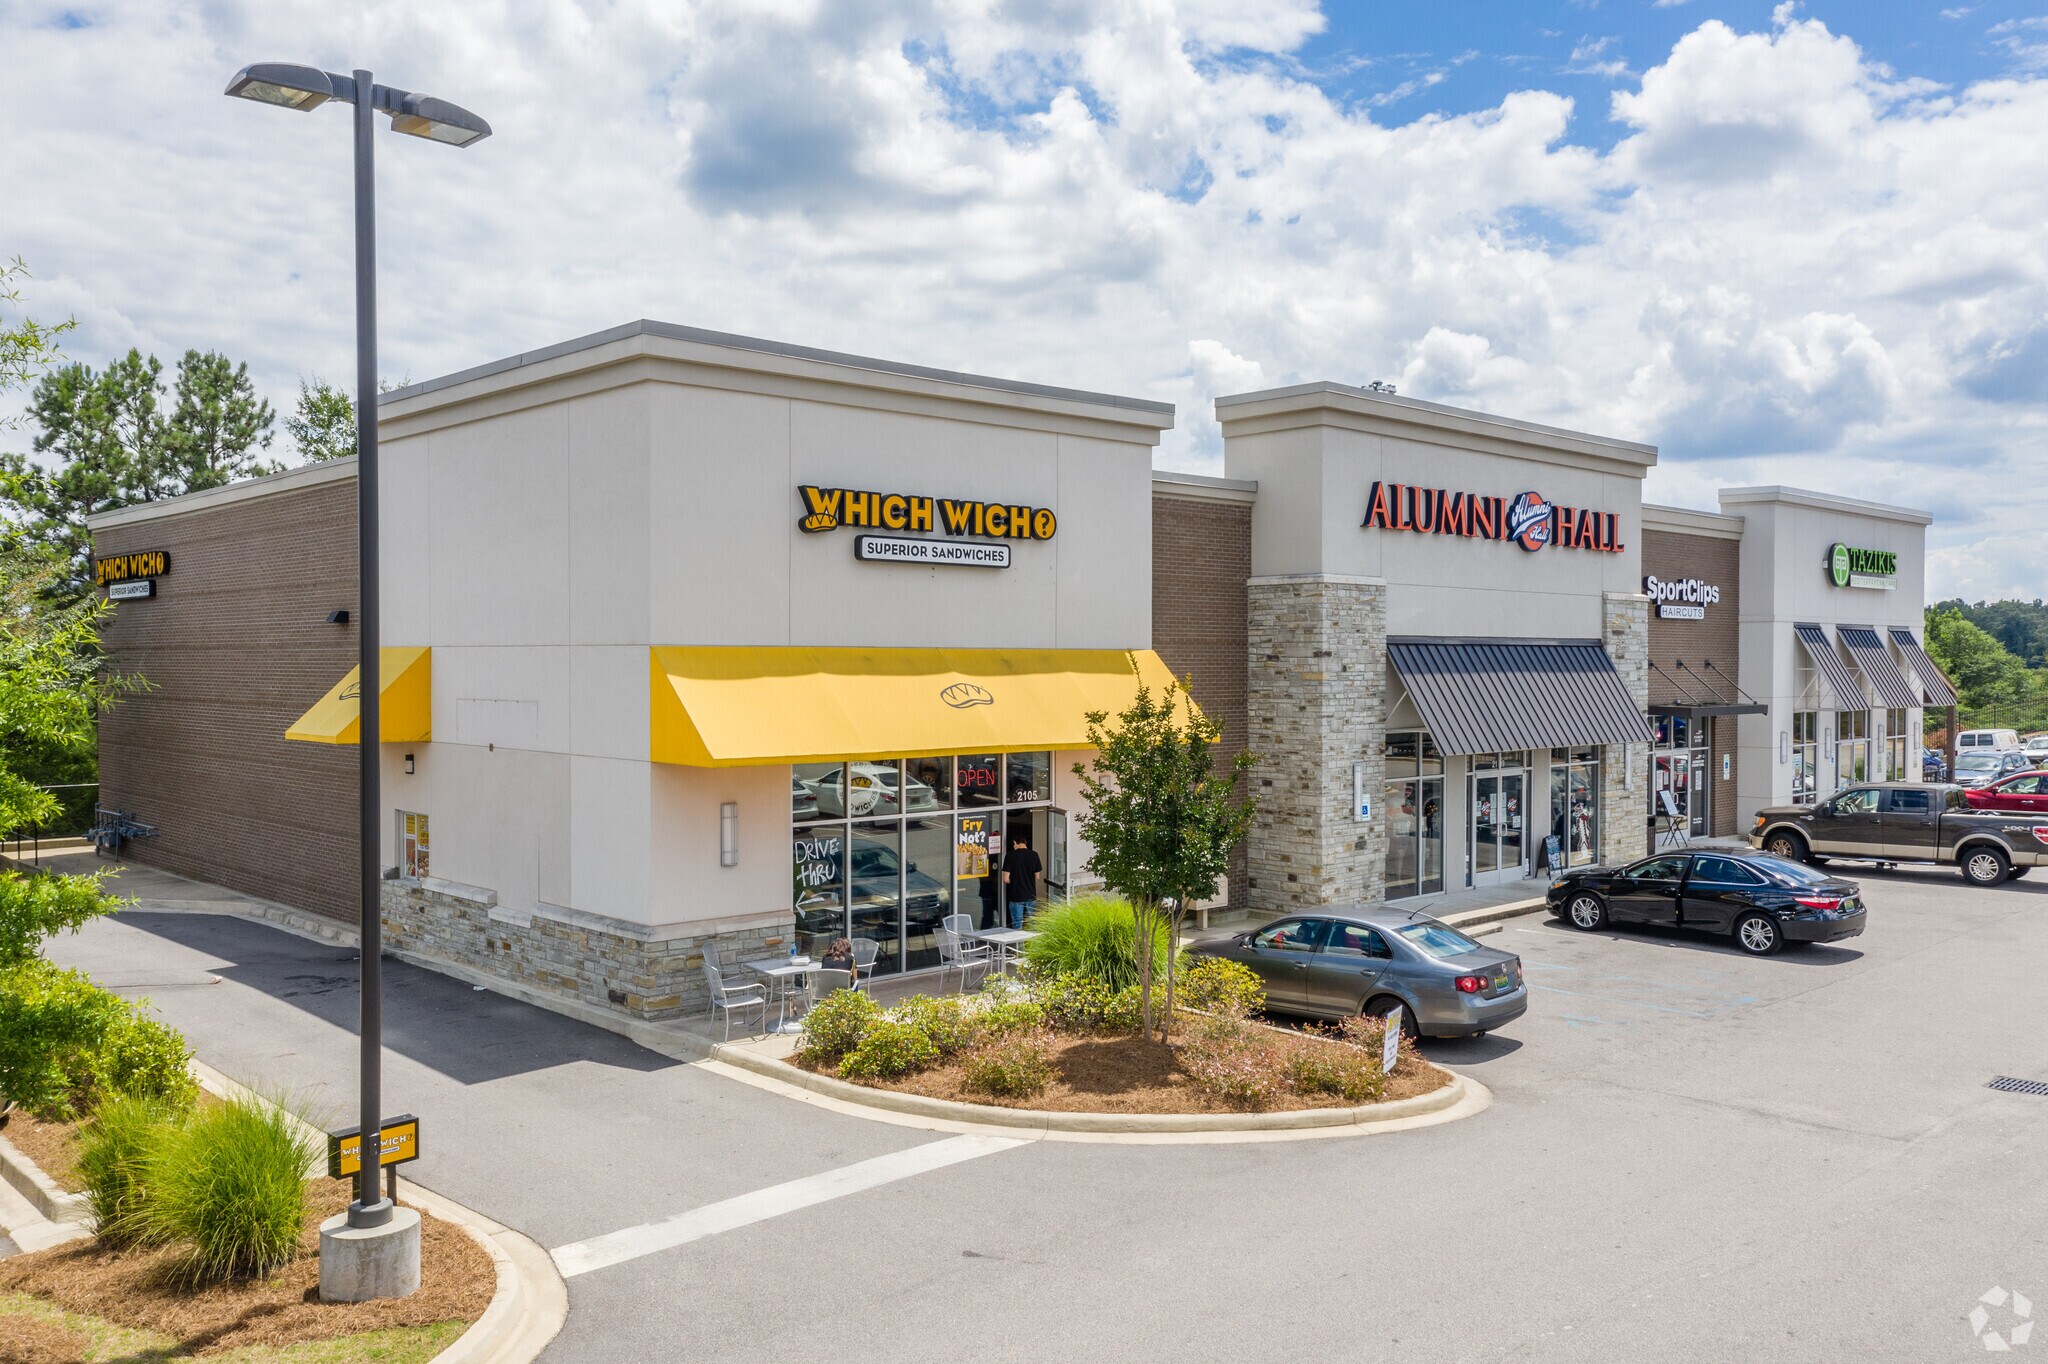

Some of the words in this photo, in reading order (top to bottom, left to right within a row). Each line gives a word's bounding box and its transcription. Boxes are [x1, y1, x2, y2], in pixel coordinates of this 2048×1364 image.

[798, 485, 934, 533] WHICH
[1360, 481, 1508, 541] ALUMNI
[1551, 505, 1625, 552] HALL
[1511, 494, 1551, 527] Alumni
[1530, 525, 1550, 540] Hall
[867, 542, 928, 558] SUPERIOR
[931, 546, 1005, 562] SANDWICHES
[96, 556, 128, 580] WHICH
[1647, 575, 1720, 608] SportClips
[1661, 606, 1703, 618] HAIRCUTS
[957, 769, 995, 787] OPEN
[1017, 790, 1038, 801] 2105
[963, 819, 983, 832] Fry
[959, 830, 986, 845] Not?
